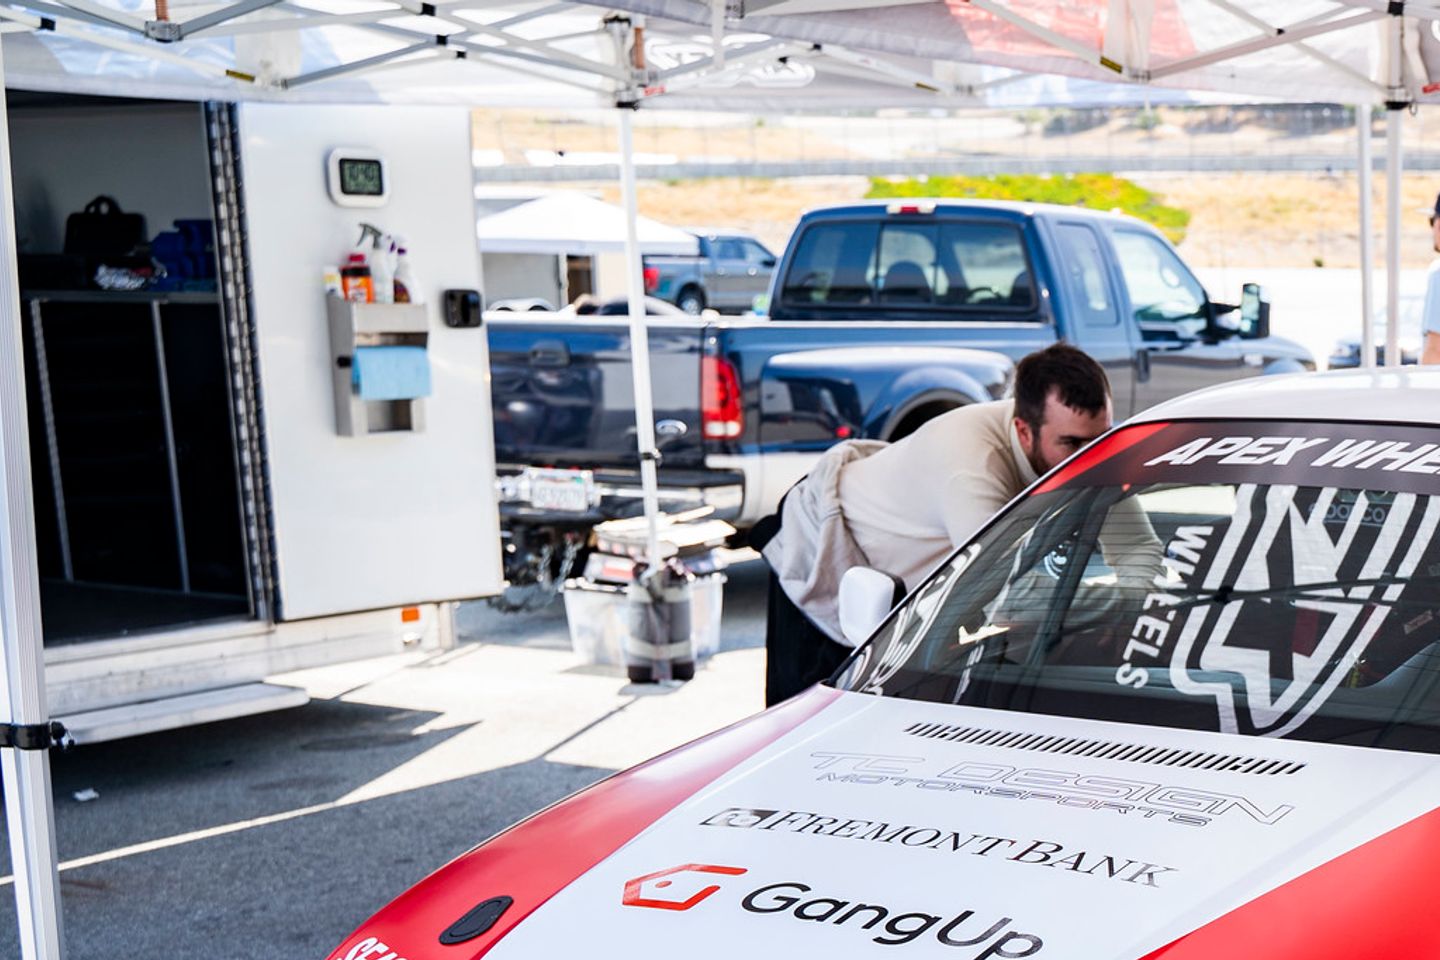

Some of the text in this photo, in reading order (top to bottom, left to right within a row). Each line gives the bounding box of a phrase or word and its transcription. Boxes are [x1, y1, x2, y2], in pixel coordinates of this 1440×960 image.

[1143, 436, 1328, 468] APEX
[1114, 524, 1214, 690] WHEELS
[816, 772, 1211, 828] MOTORSPORTS
[936, 760, 1295, 827] DESIGN
[760, 809, 1180, 889] FREMONT BANK
